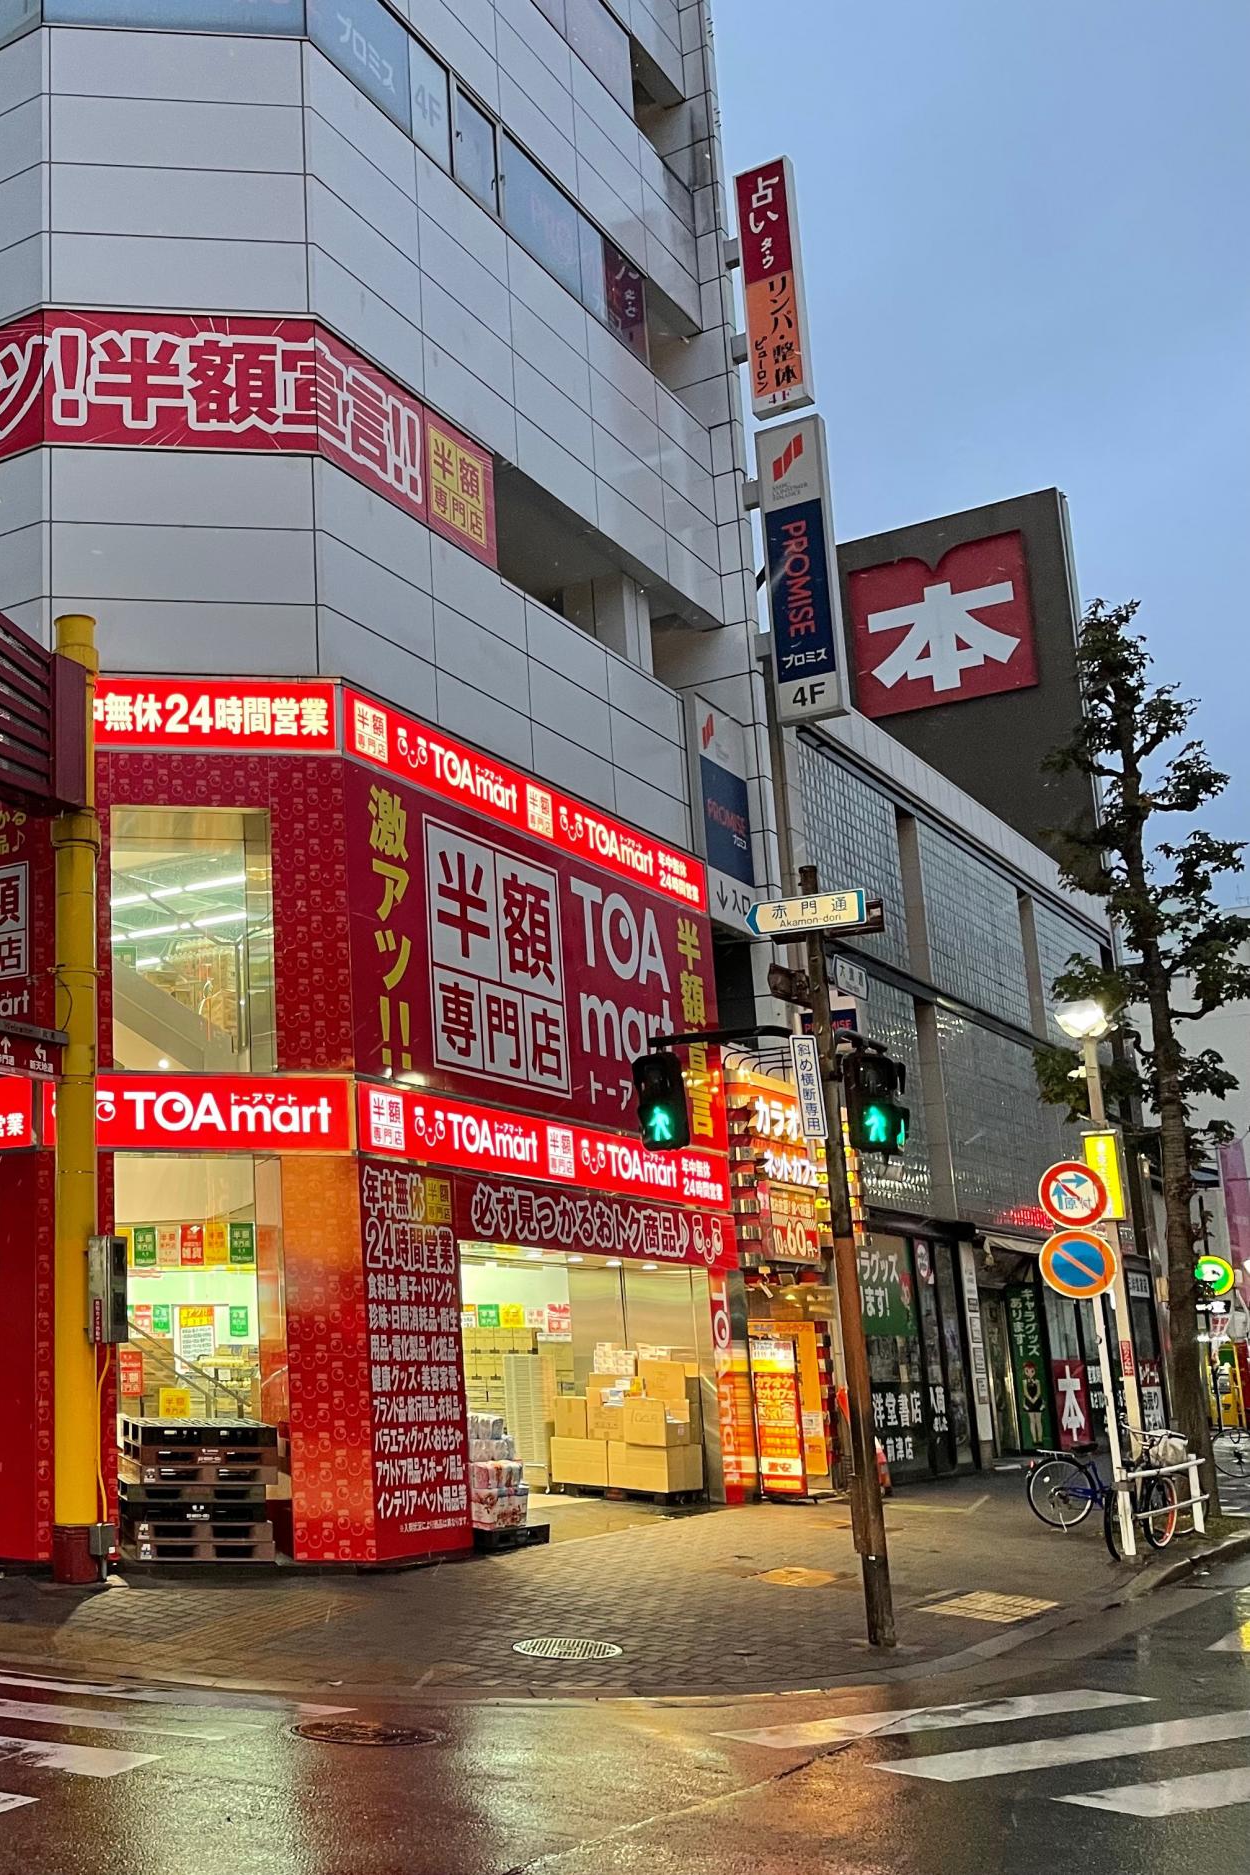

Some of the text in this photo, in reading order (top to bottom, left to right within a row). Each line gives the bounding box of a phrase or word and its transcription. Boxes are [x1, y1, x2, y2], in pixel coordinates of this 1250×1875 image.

[750, 177, 779, 233] 占い
[432, 438, 482, 505] 半額
[432, 486, 484, 540] 専門店
[782, 519, 816, 638] PROMISE
[781, 648, 828, 670] プロミス
[867, 581, 1021, 692] 本
[792, 681, 826, 707] 4F
[356, 706, 385, 738] 半額
[436, 850, 557, 987] 半額
[732, 888, 751, 916] 入口
[771, 896, 847, 920] 赤門通
[779, 914, 842, 929] Akamon-dori
[569, 876, 671, 994] TOA
[438, 981, 562, 1078] 専門店
[579, 991, 675, 1064] mart
[231, 1092, 298, 1104] トーアマート
[590, 1070, 633, 1111] トーア
[797, 1043, 821, 1131] 斜め横断専用
[123, 1091, 332, 1133] TOAmart
[372, 1097, 402, 1124] 半額
[755, 1096, 804, 1143] カラオ
[373, 1125, 403, 1146] 専門店
[448, 1112, 538, 1163] TOAmart
[549, 1131, 572, 1157] 半額
[607, 1143, 677, 1188] TOAmart
[764, 1149, 820, 1187] ネットカフェ
[363, 1165, 426, 1222] 年中無休
[365, 1217, 455, 1275] 24時間営業
[856, 1250, 900, 1283] ラグッズ
[1021, 1288, 1040, 1357] キャラグッズ
[879, 1435, 915, 1463] 前津店
